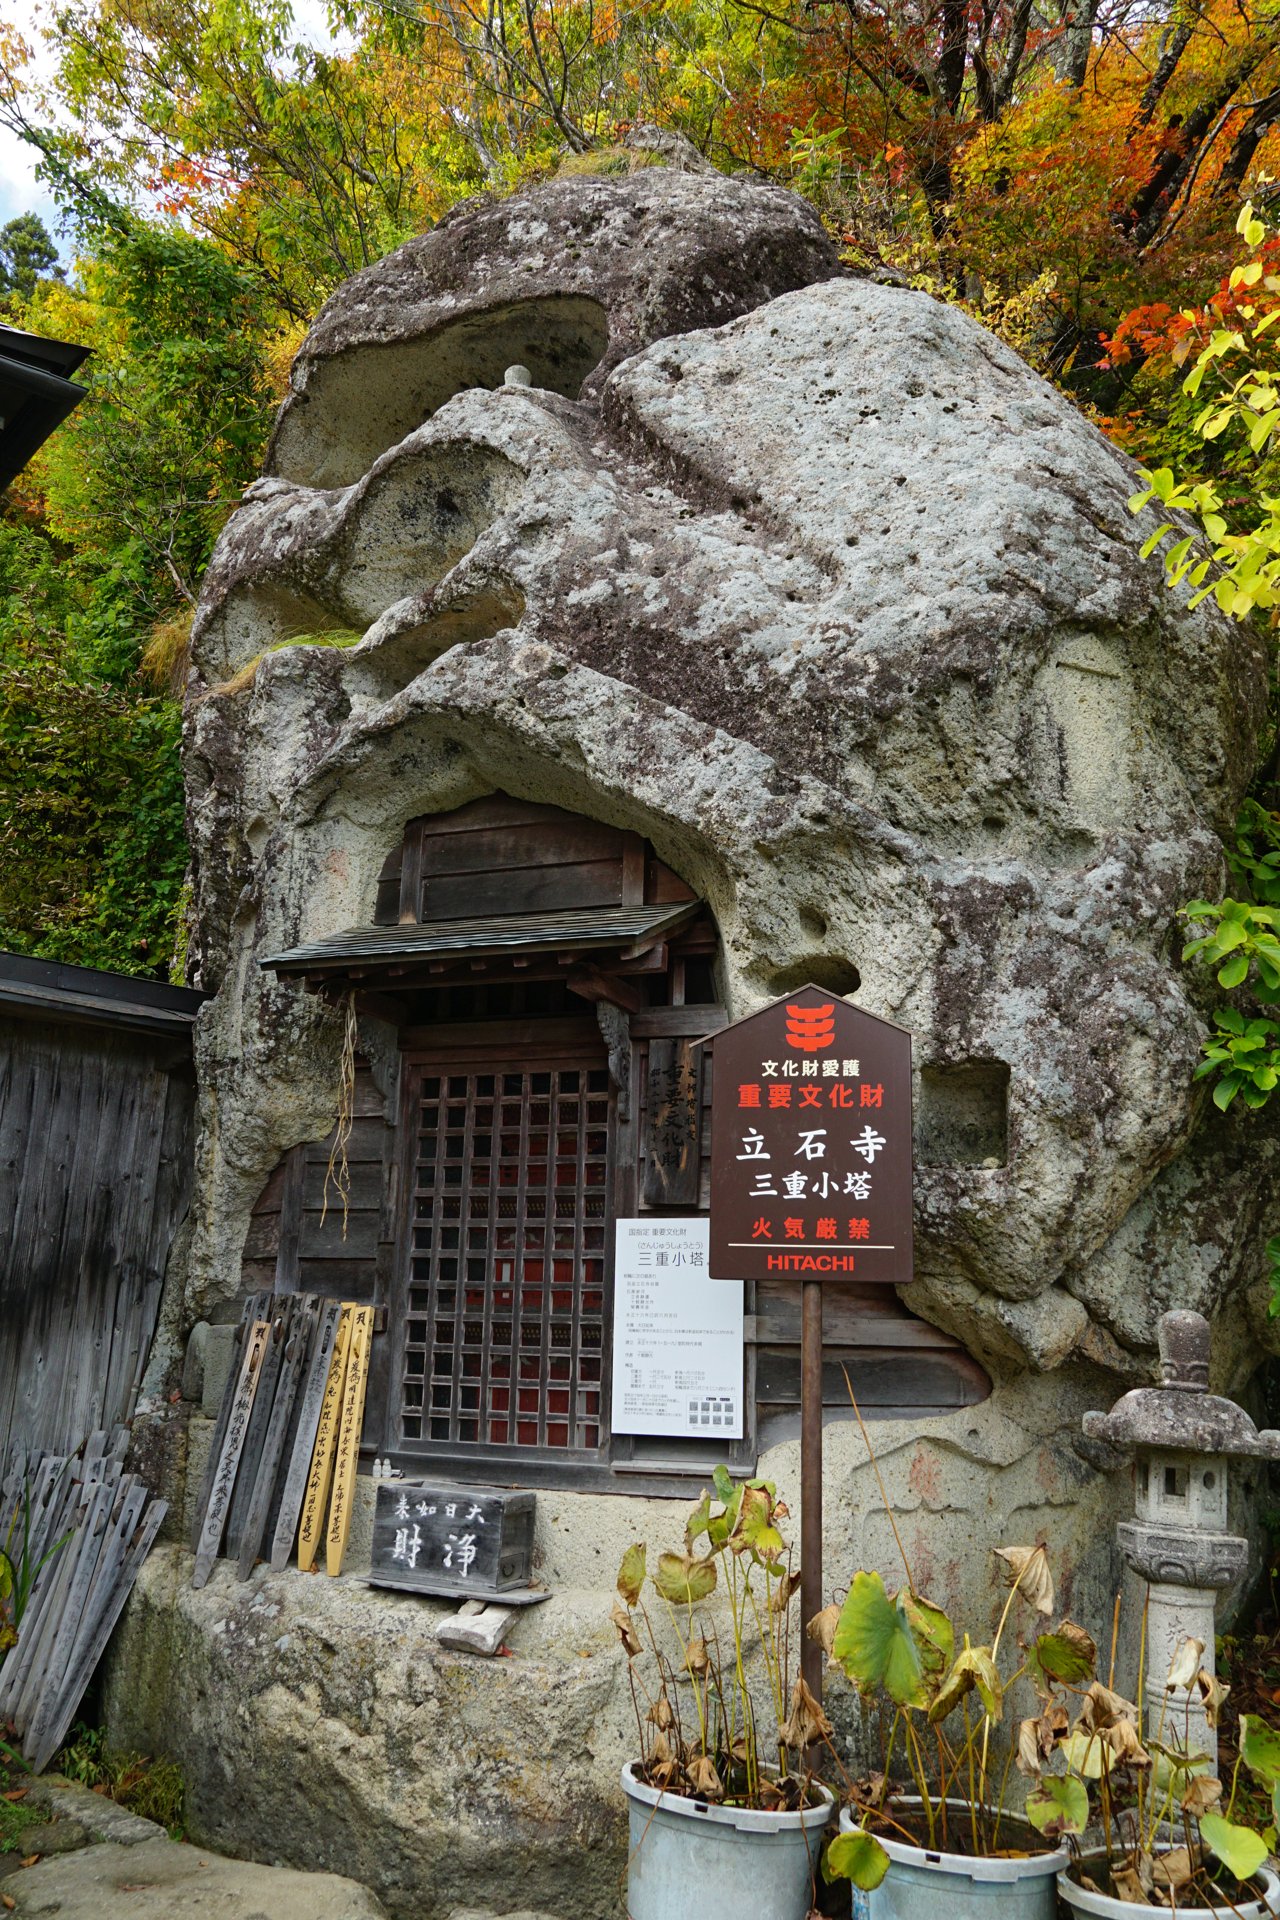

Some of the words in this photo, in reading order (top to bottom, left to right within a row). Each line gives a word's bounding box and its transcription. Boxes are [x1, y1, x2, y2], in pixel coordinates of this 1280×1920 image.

[761, 1059, 861, 1077] 文化財愛護
[737, 1083, 885, 1109] 重要文化財
[660, 1060, 685, 1168] 重要文化財
[735, 1125, 887, 1164] 立石寺
[748, 1170, 873, 1201] 三重小塔
[751, 1216, 871, 1240] 火気厳禁
[638, 1251, 704, 1267] 三重小塔
[767, 1254, 855, 1272] HITACHI
